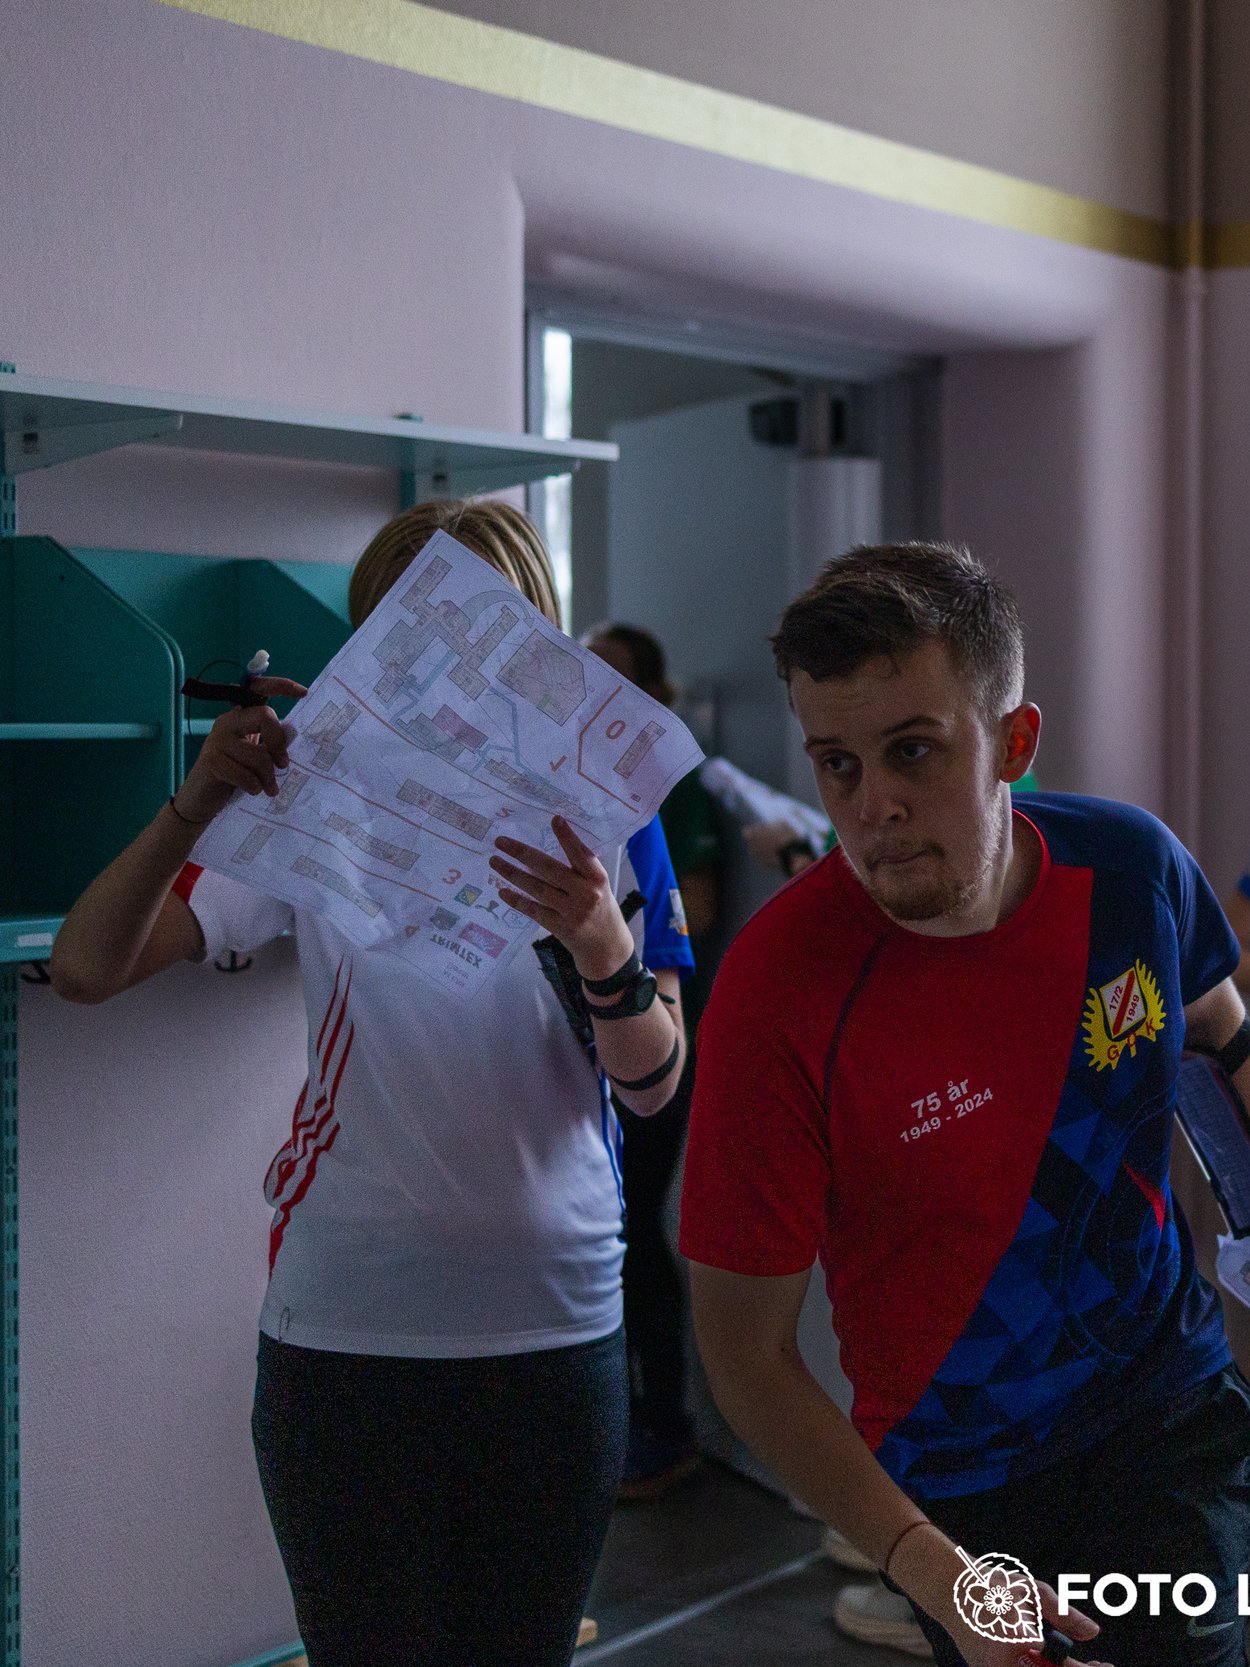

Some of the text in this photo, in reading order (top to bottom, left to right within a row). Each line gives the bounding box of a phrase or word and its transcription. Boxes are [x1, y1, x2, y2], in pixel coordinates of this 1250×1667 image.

[1109, 984, 1124, 1011] 17/2
[1126, 994, 1141, 1022] 1949
[900, 1116, 941, 1143] 1949
[954, 1087, 994, 1119] 2024
[911, 1078, 969, 1119] 75 år
